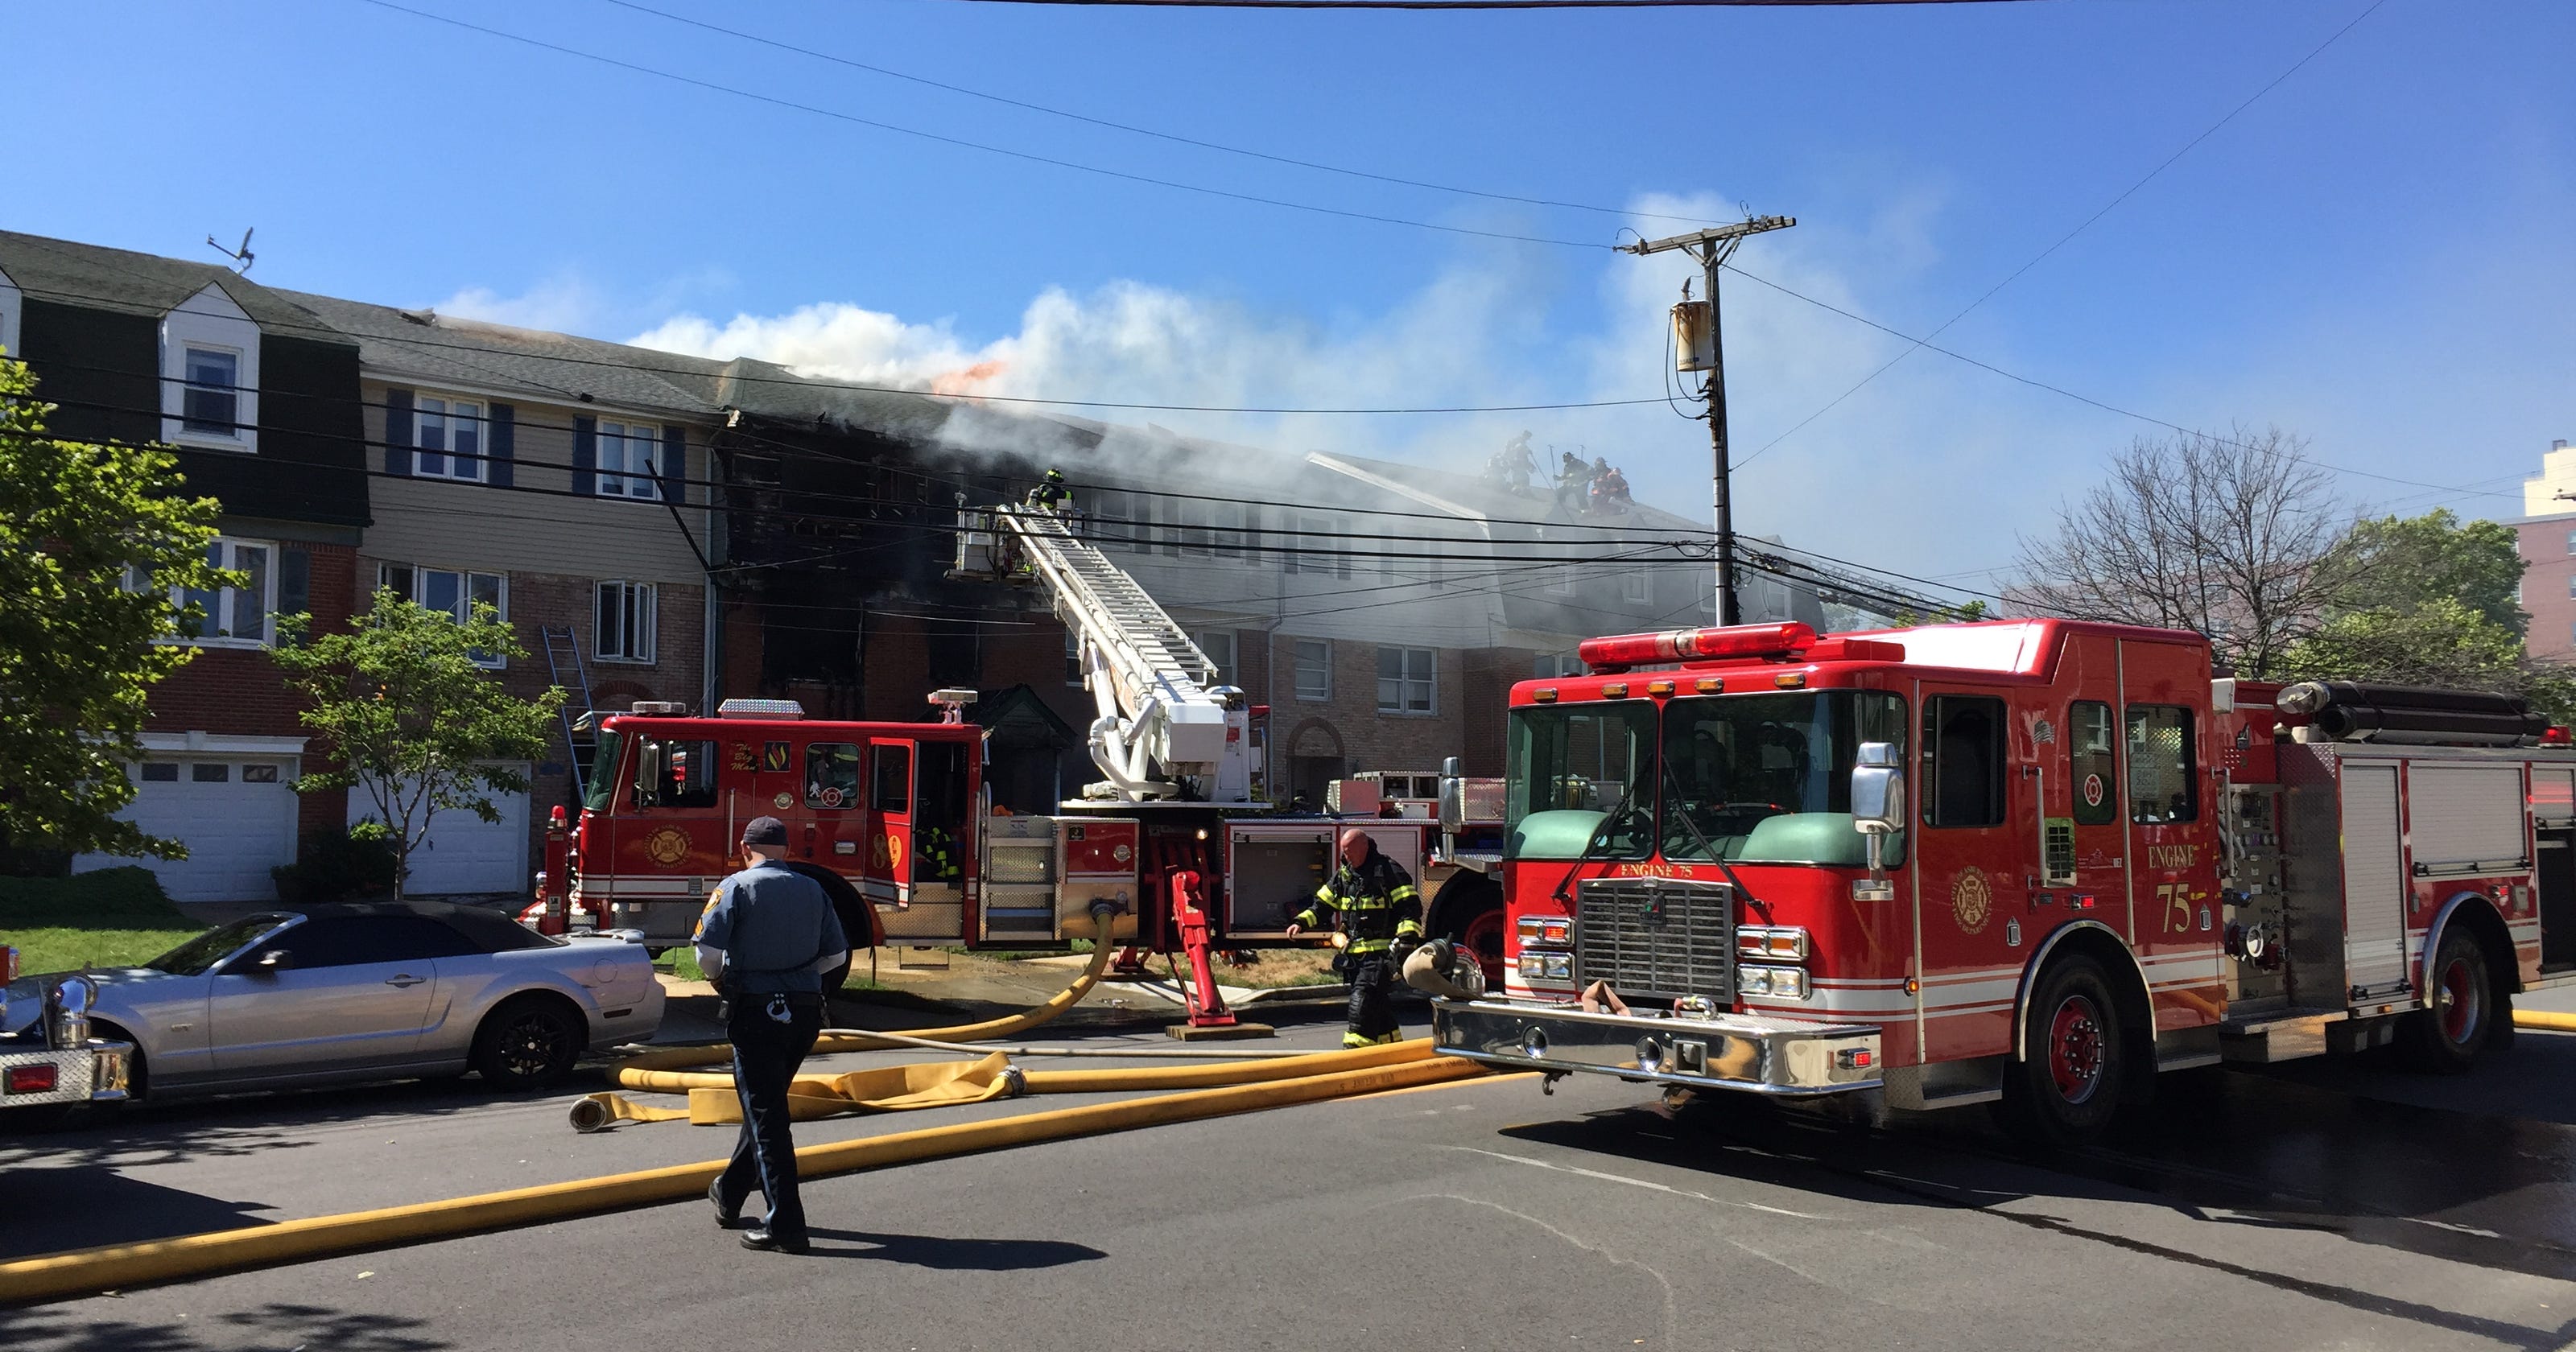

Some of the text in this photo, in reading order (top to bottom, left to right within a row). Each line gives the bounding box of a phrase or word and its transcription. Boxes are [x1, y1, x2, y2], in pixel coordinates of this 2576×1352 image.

[734, 752, 753, 763] Big
[2148, 845, 2195, 868] ENGINE
[1621, 864, 1693, 878] ENGINE 75
[2157, 883, 2190, 933] 75
